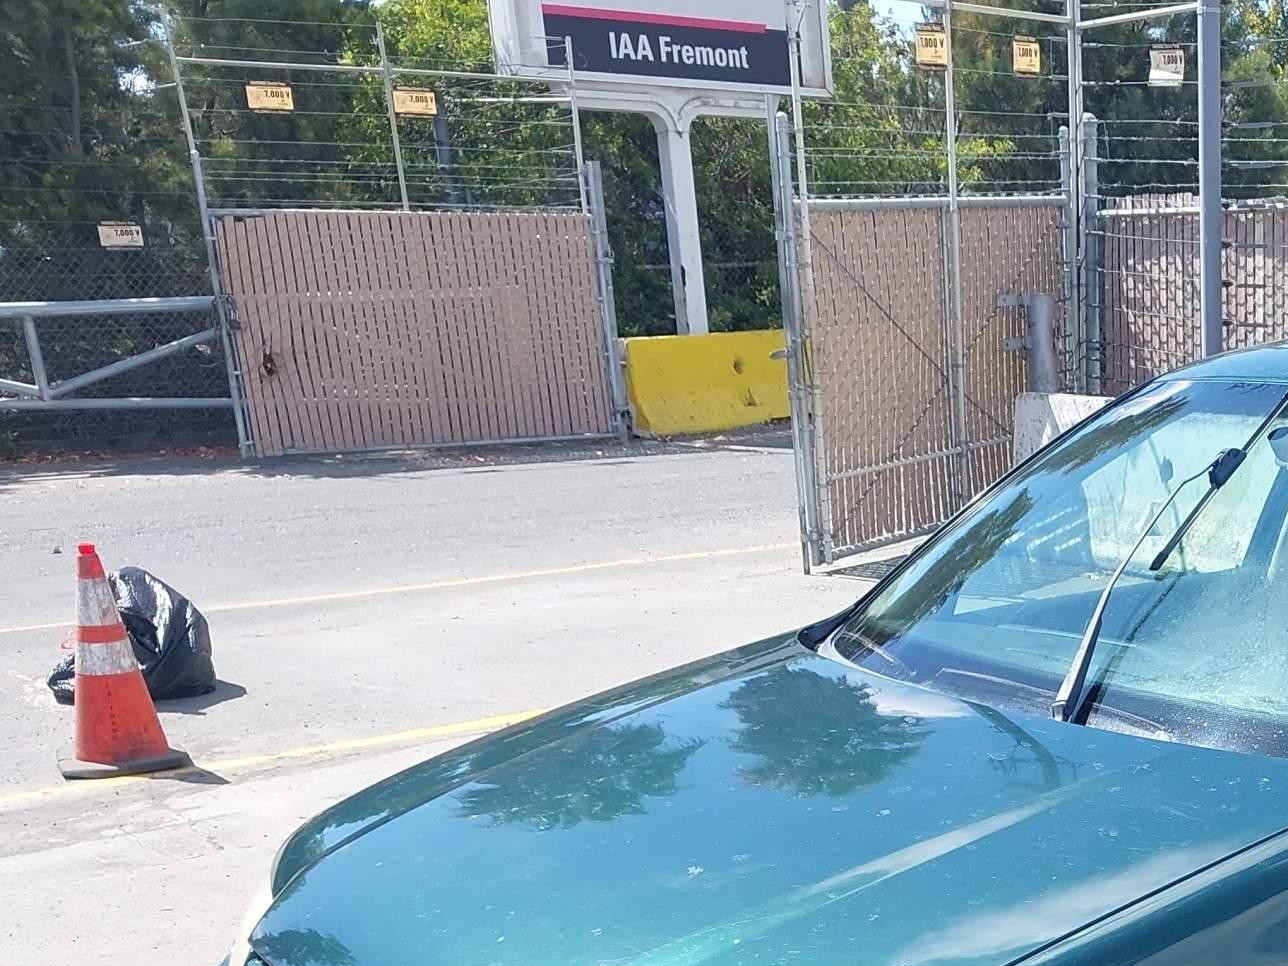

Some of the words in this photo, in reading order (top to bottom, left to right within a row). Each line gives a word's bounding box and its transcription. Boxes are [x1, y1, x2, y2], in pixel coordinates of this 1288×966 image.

[939, 38, 945, 48] V
[608, 31, 655, 63] IAA
[658, 35, 750, 70] Fremont
[1034, 48, 1038, 57] V
[1179, 54, 1183, 64] V
[285, 90, 290, 99] V
[429, 95, 433, 103] V
[134, 229, 140, 237] V
